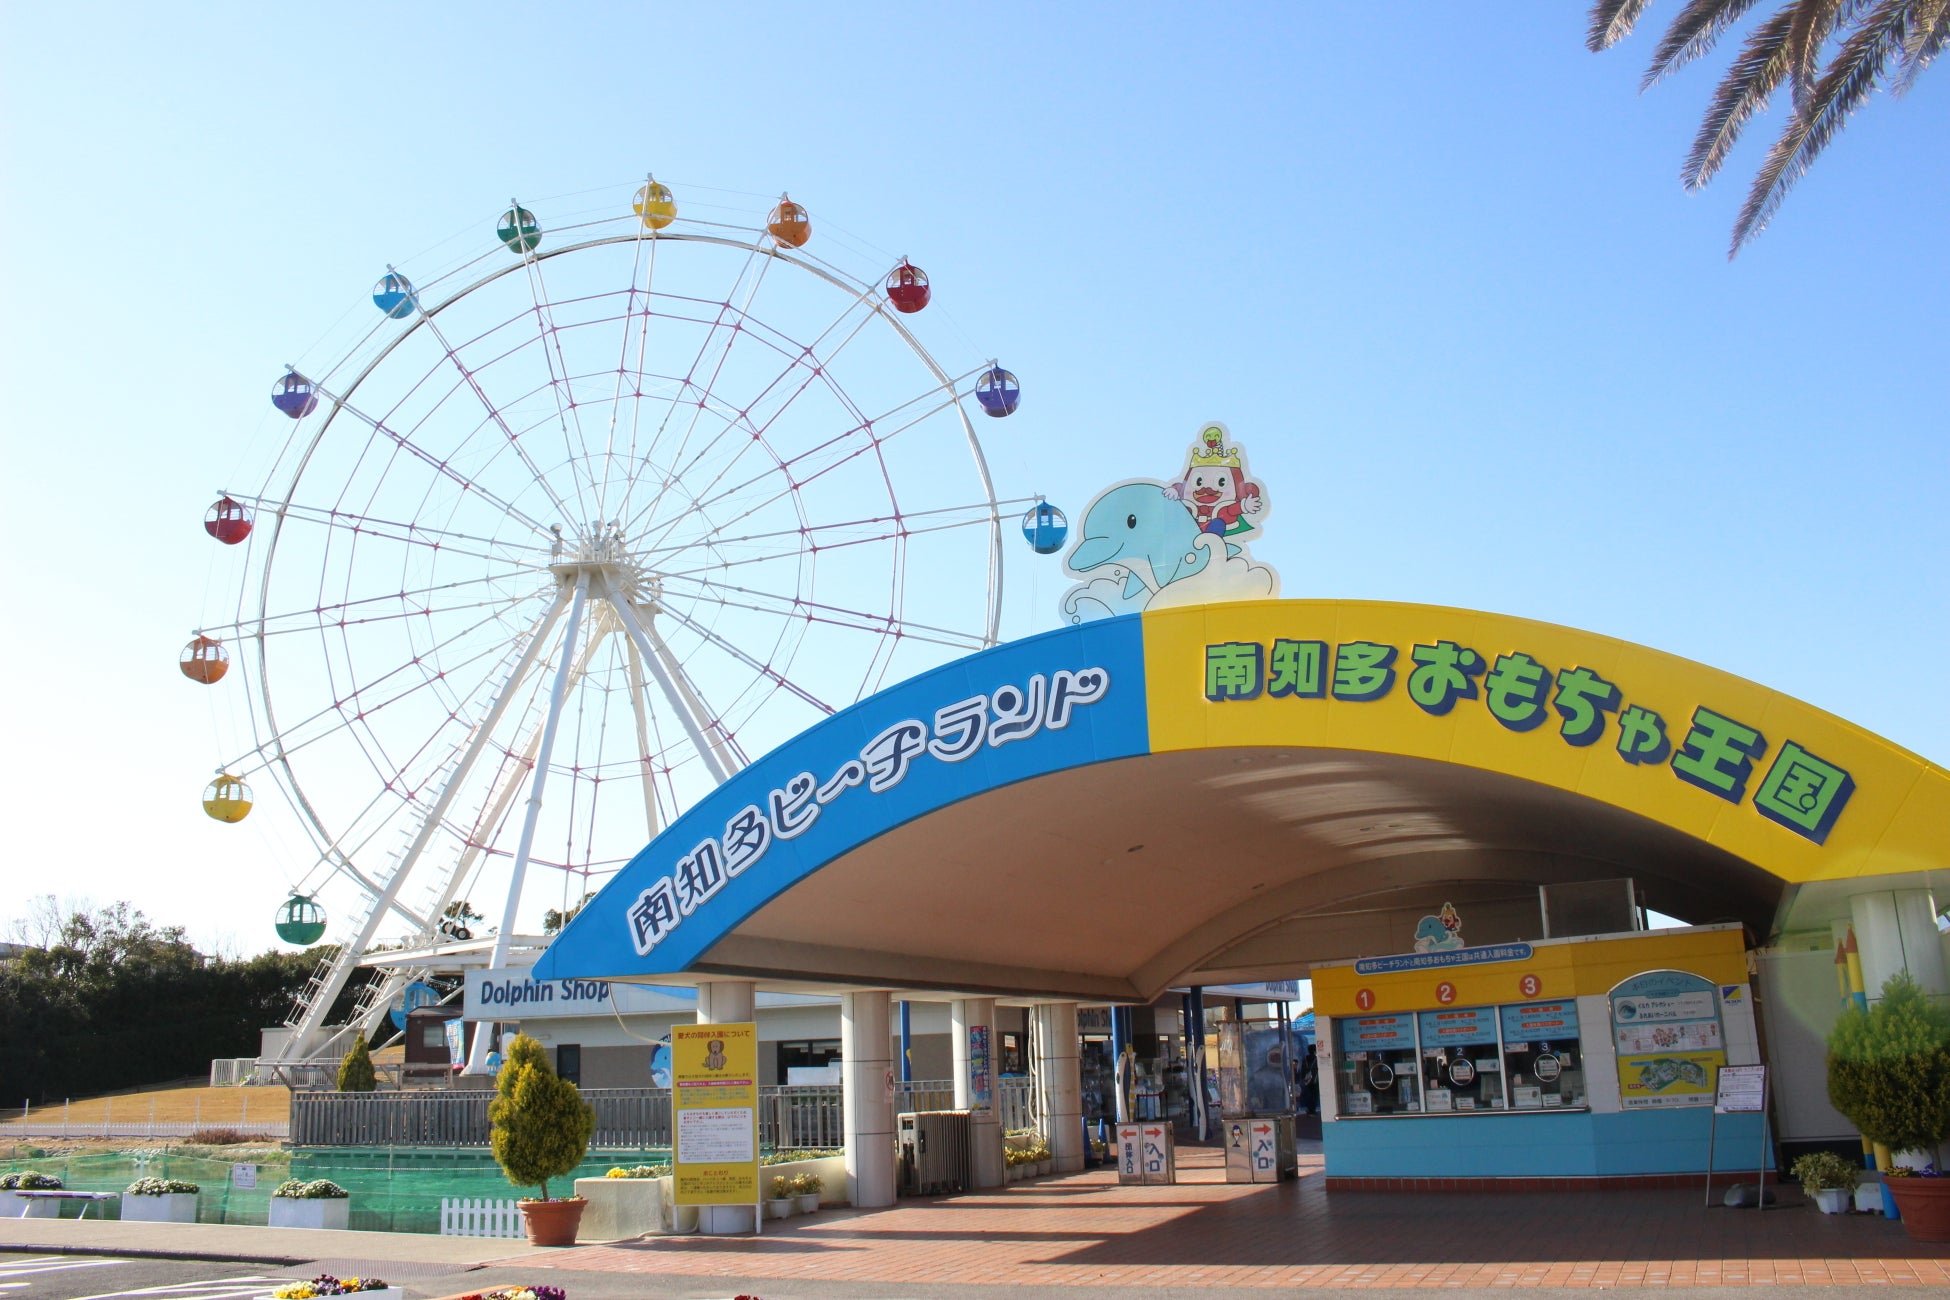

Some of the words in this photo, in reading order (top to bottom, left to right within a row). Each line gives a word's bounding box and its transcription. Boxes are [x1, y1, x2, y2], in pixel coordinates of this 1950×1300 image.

[1205, 639, 1856, 846] 南知多おもちゃ王国
[627, 667, 1110, 956] 南知多ビーチランド
[481, 978, 553, 1006] Dolphin
[561, 978, 609, 1003] Shop
[1360, 991, 1369, 1008] 1
[1440, 984, 1451, 1001] 2
[1524, 976, 1536, 995] 3
[1457, 1047, 1464, 1056] 2
[1542, 1042, 1549, 1051] 3
[1125, 1143, 1134, 1174] 団体入口
[1149, 1143, 1161, 1172] 入口
[1257, 1139, 1270, 1170] 入口
